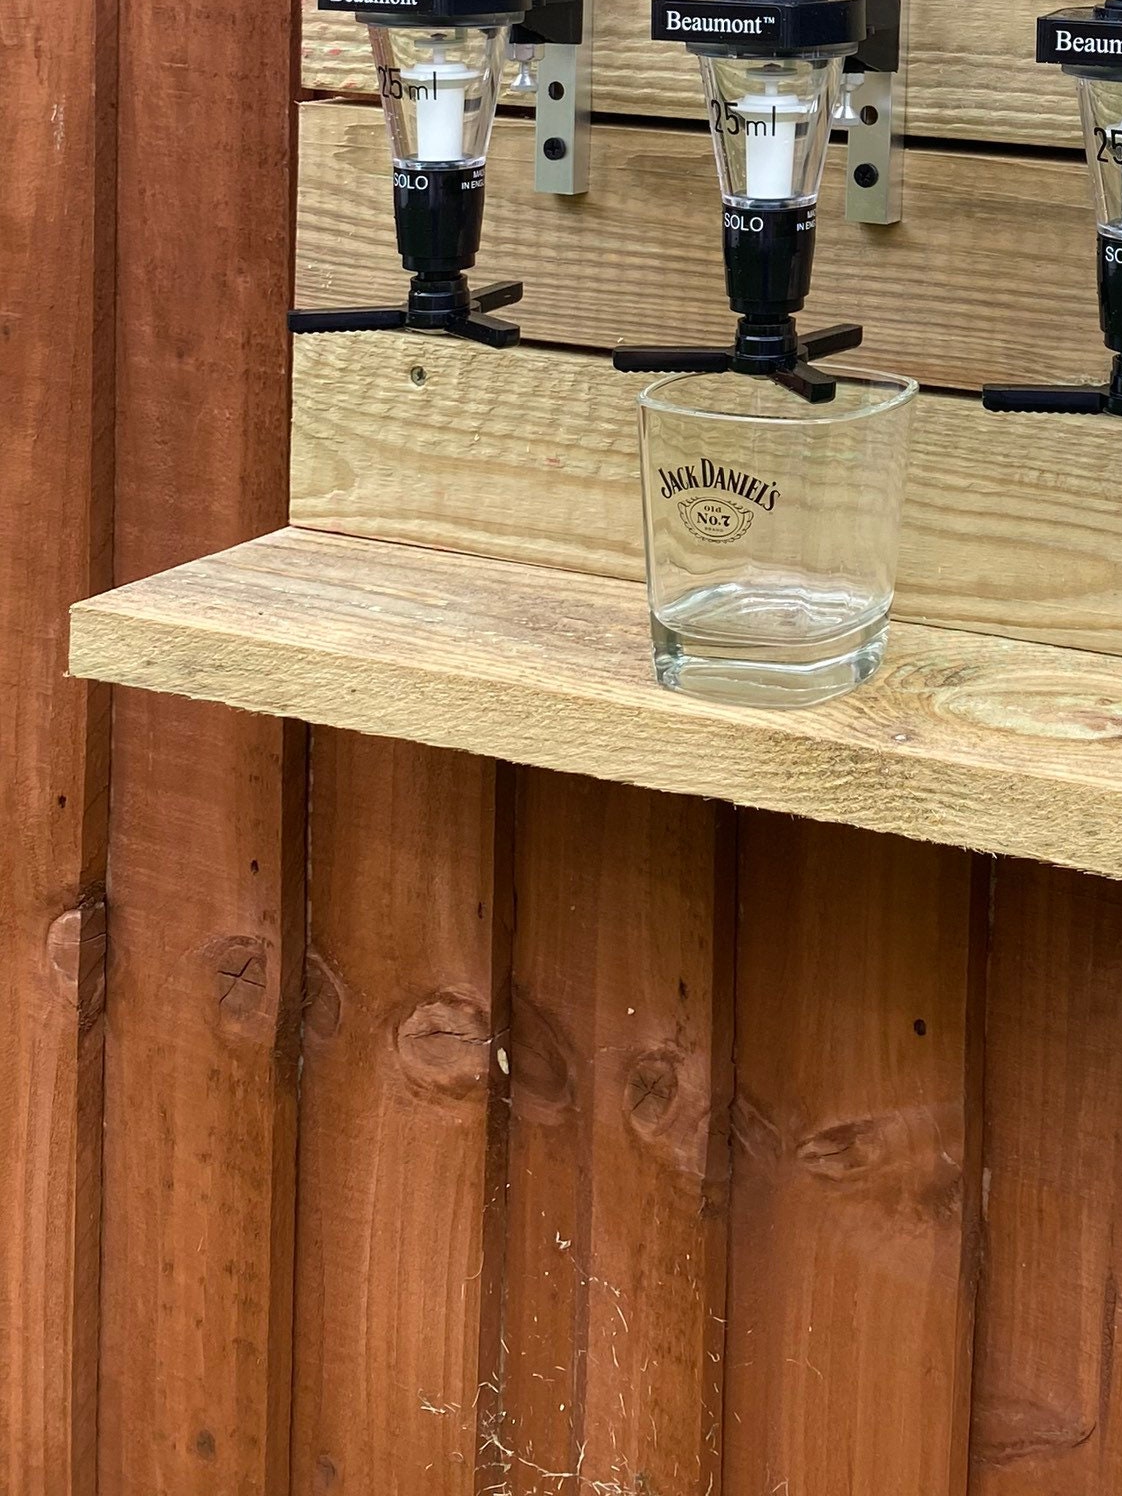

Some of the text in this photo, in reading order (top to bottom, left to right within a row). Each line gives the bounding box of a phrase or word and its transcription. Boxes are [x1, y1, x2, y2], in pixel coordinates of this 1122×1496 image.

[394, 172, 429, 190] SOLO
[461, 182, 470, 190] IN
[724, 212, 764, 232] SOLO
[658, 458, 781, 512] JACK DANIEL'S
[704, 505, 722, 513] Old
